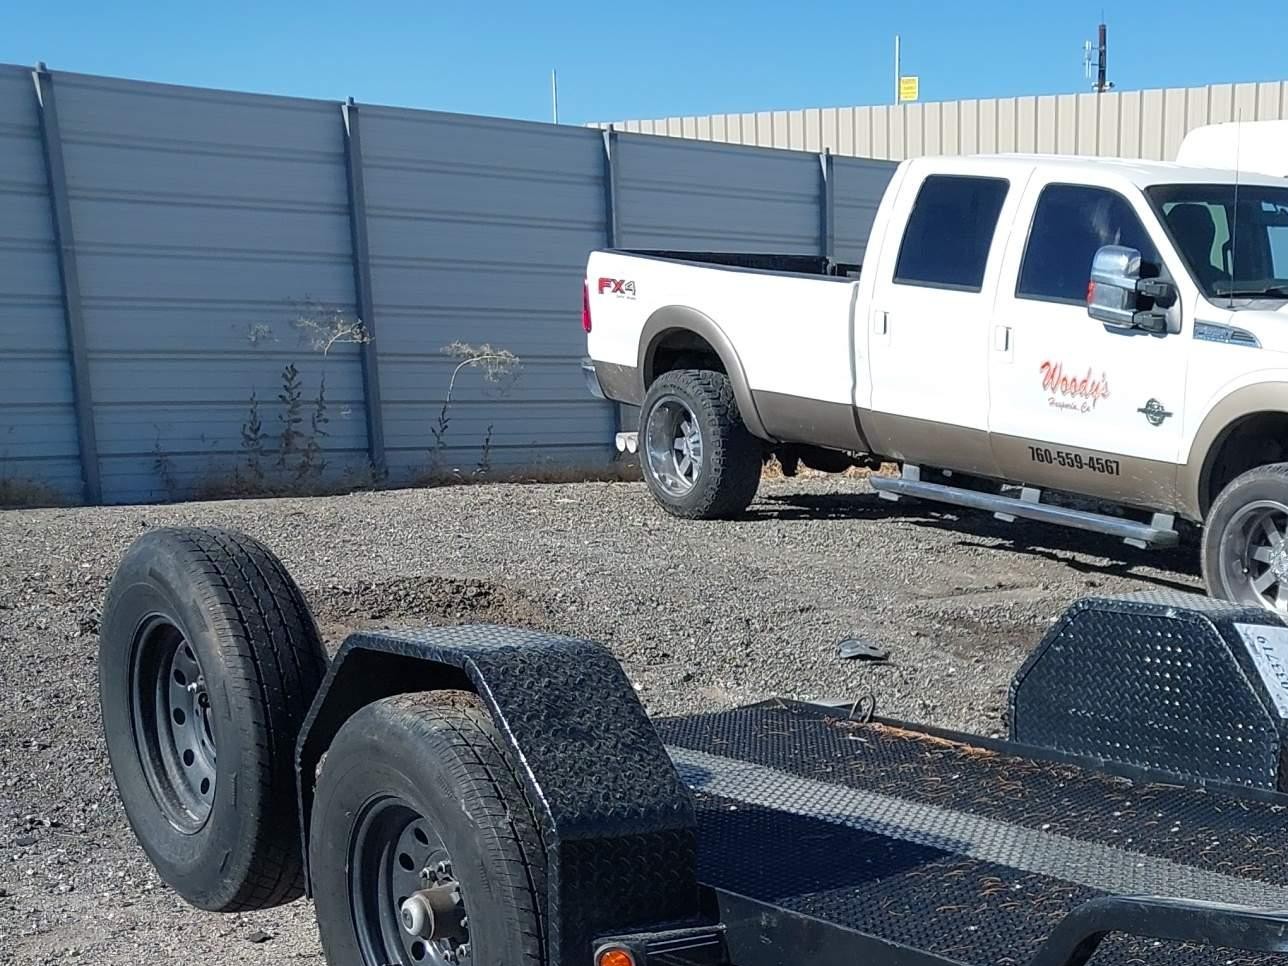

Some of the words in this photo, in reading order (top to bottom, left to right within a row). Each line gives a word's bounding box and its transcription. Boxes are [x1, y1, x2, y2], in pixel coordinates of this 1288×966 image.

[598, 277, 636, 296] FX4
[1040, 360, 1110, 409] Woody's
[1028, 446, 1121, 476] 760-559-4567
